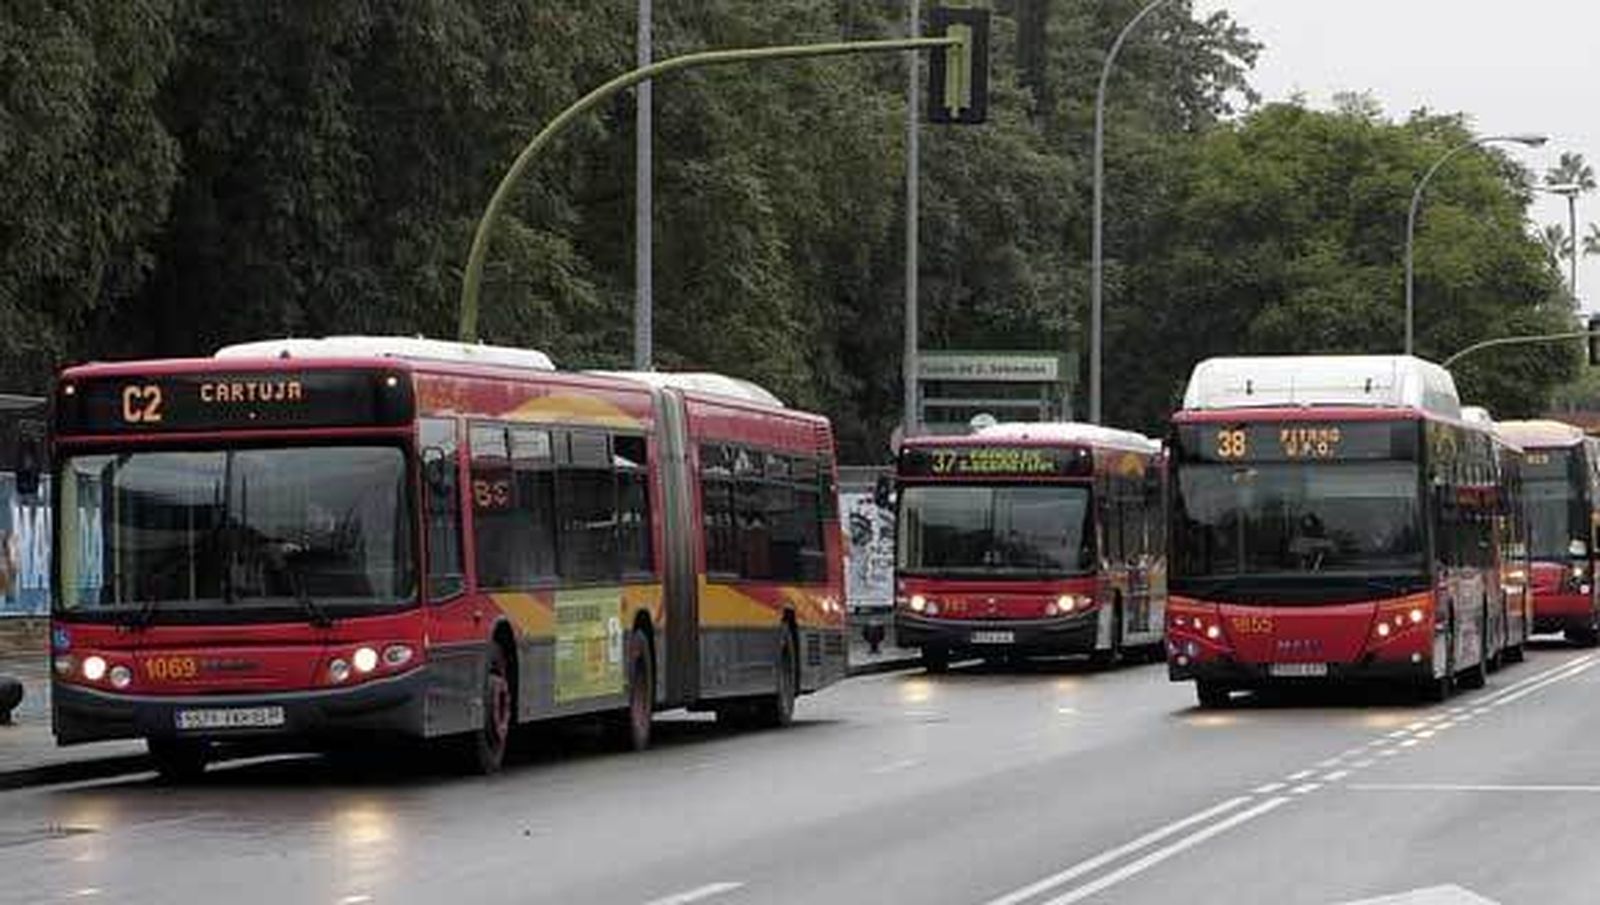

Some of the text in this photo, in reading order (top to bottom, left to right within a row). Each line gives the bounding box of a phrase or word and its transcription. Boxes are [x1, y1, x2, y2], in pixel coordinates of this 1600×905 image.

[123, 384, 162, 422] C2
[201, 382, 302, 402] CARTUJA
[1218, 430, 1246, 457] 38
[931, 450, 957, 473] 37
[145, 657, 197, 680] 1069
